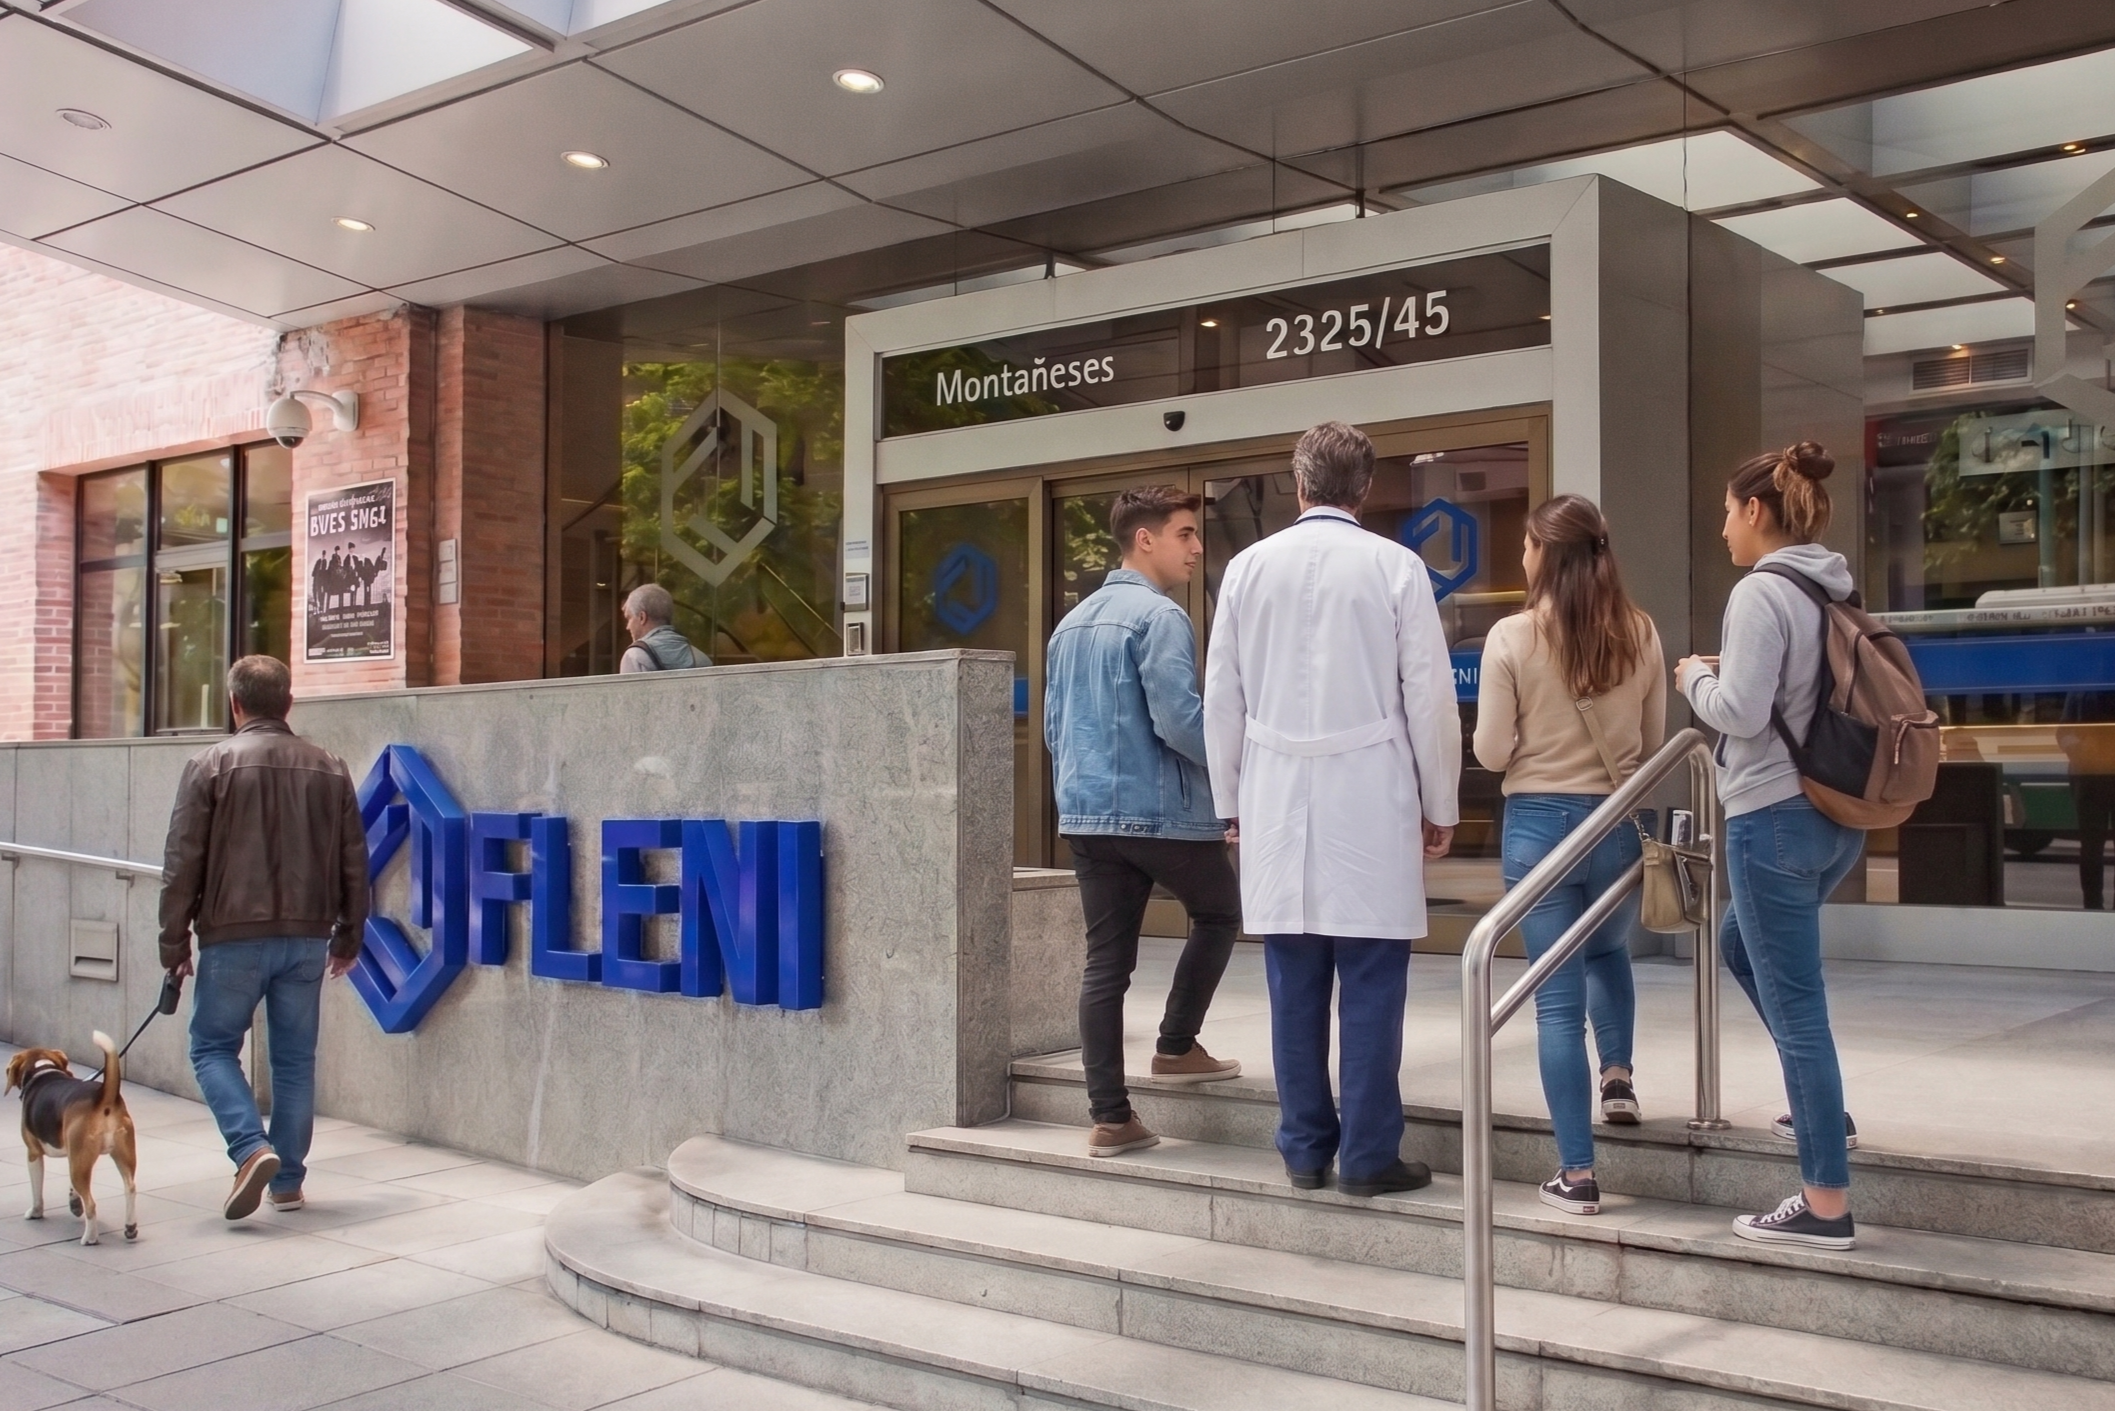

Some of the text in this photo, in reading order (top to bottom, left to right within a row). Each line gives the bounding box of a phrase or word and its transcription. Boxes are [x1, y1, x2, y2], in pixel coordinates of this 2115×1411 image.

[936, 289, 1450, 406] Montañeses 2325/45
[469, 811, 823, 1011] FLENI
